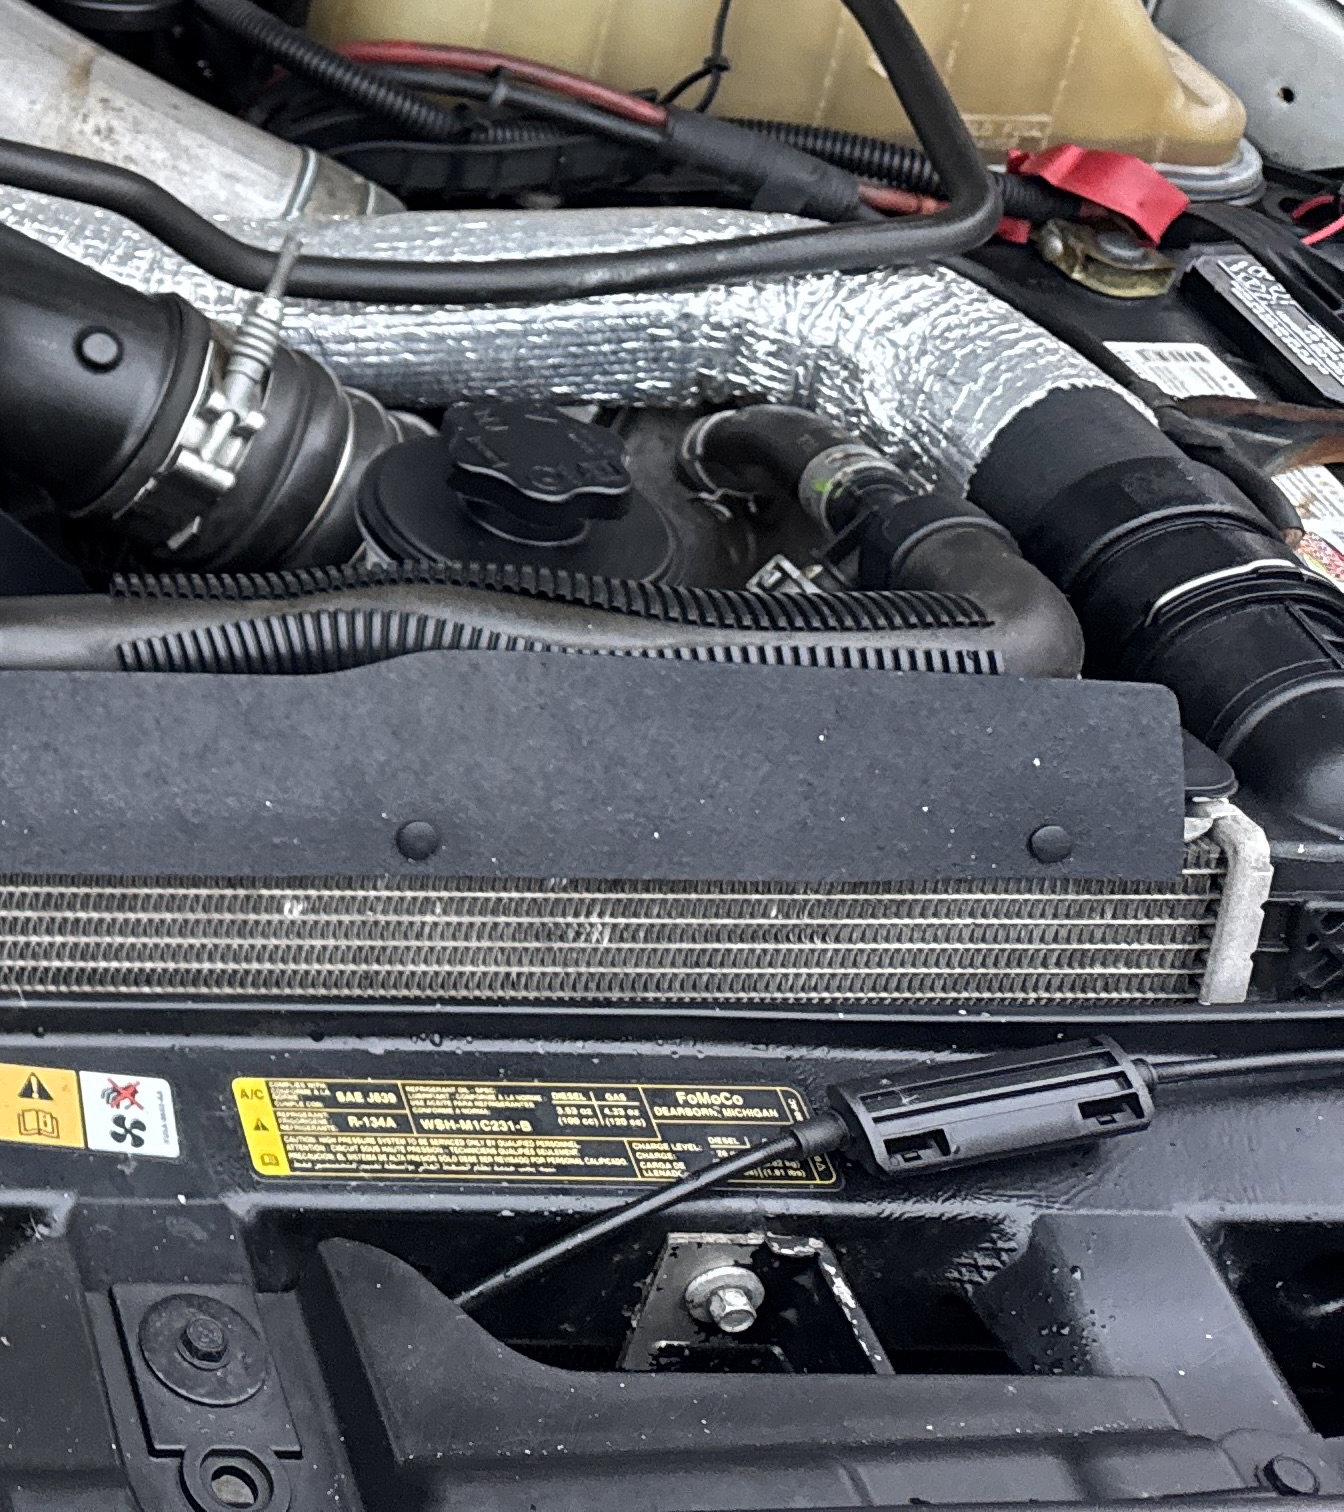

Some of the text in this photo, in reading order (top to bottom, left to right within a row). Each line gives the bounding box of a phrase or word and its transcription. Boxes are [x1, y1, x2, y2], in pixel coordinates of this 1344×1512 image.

[240, 1089, 264, 1100] A/C
[605, 1093, 627, 1101] GAS
[676, 1091, 744, 1105] FoMoCo
[722, 1108, 778, 1118] MICHIGAN
[347, 1116, 397, 1129] R-134A
